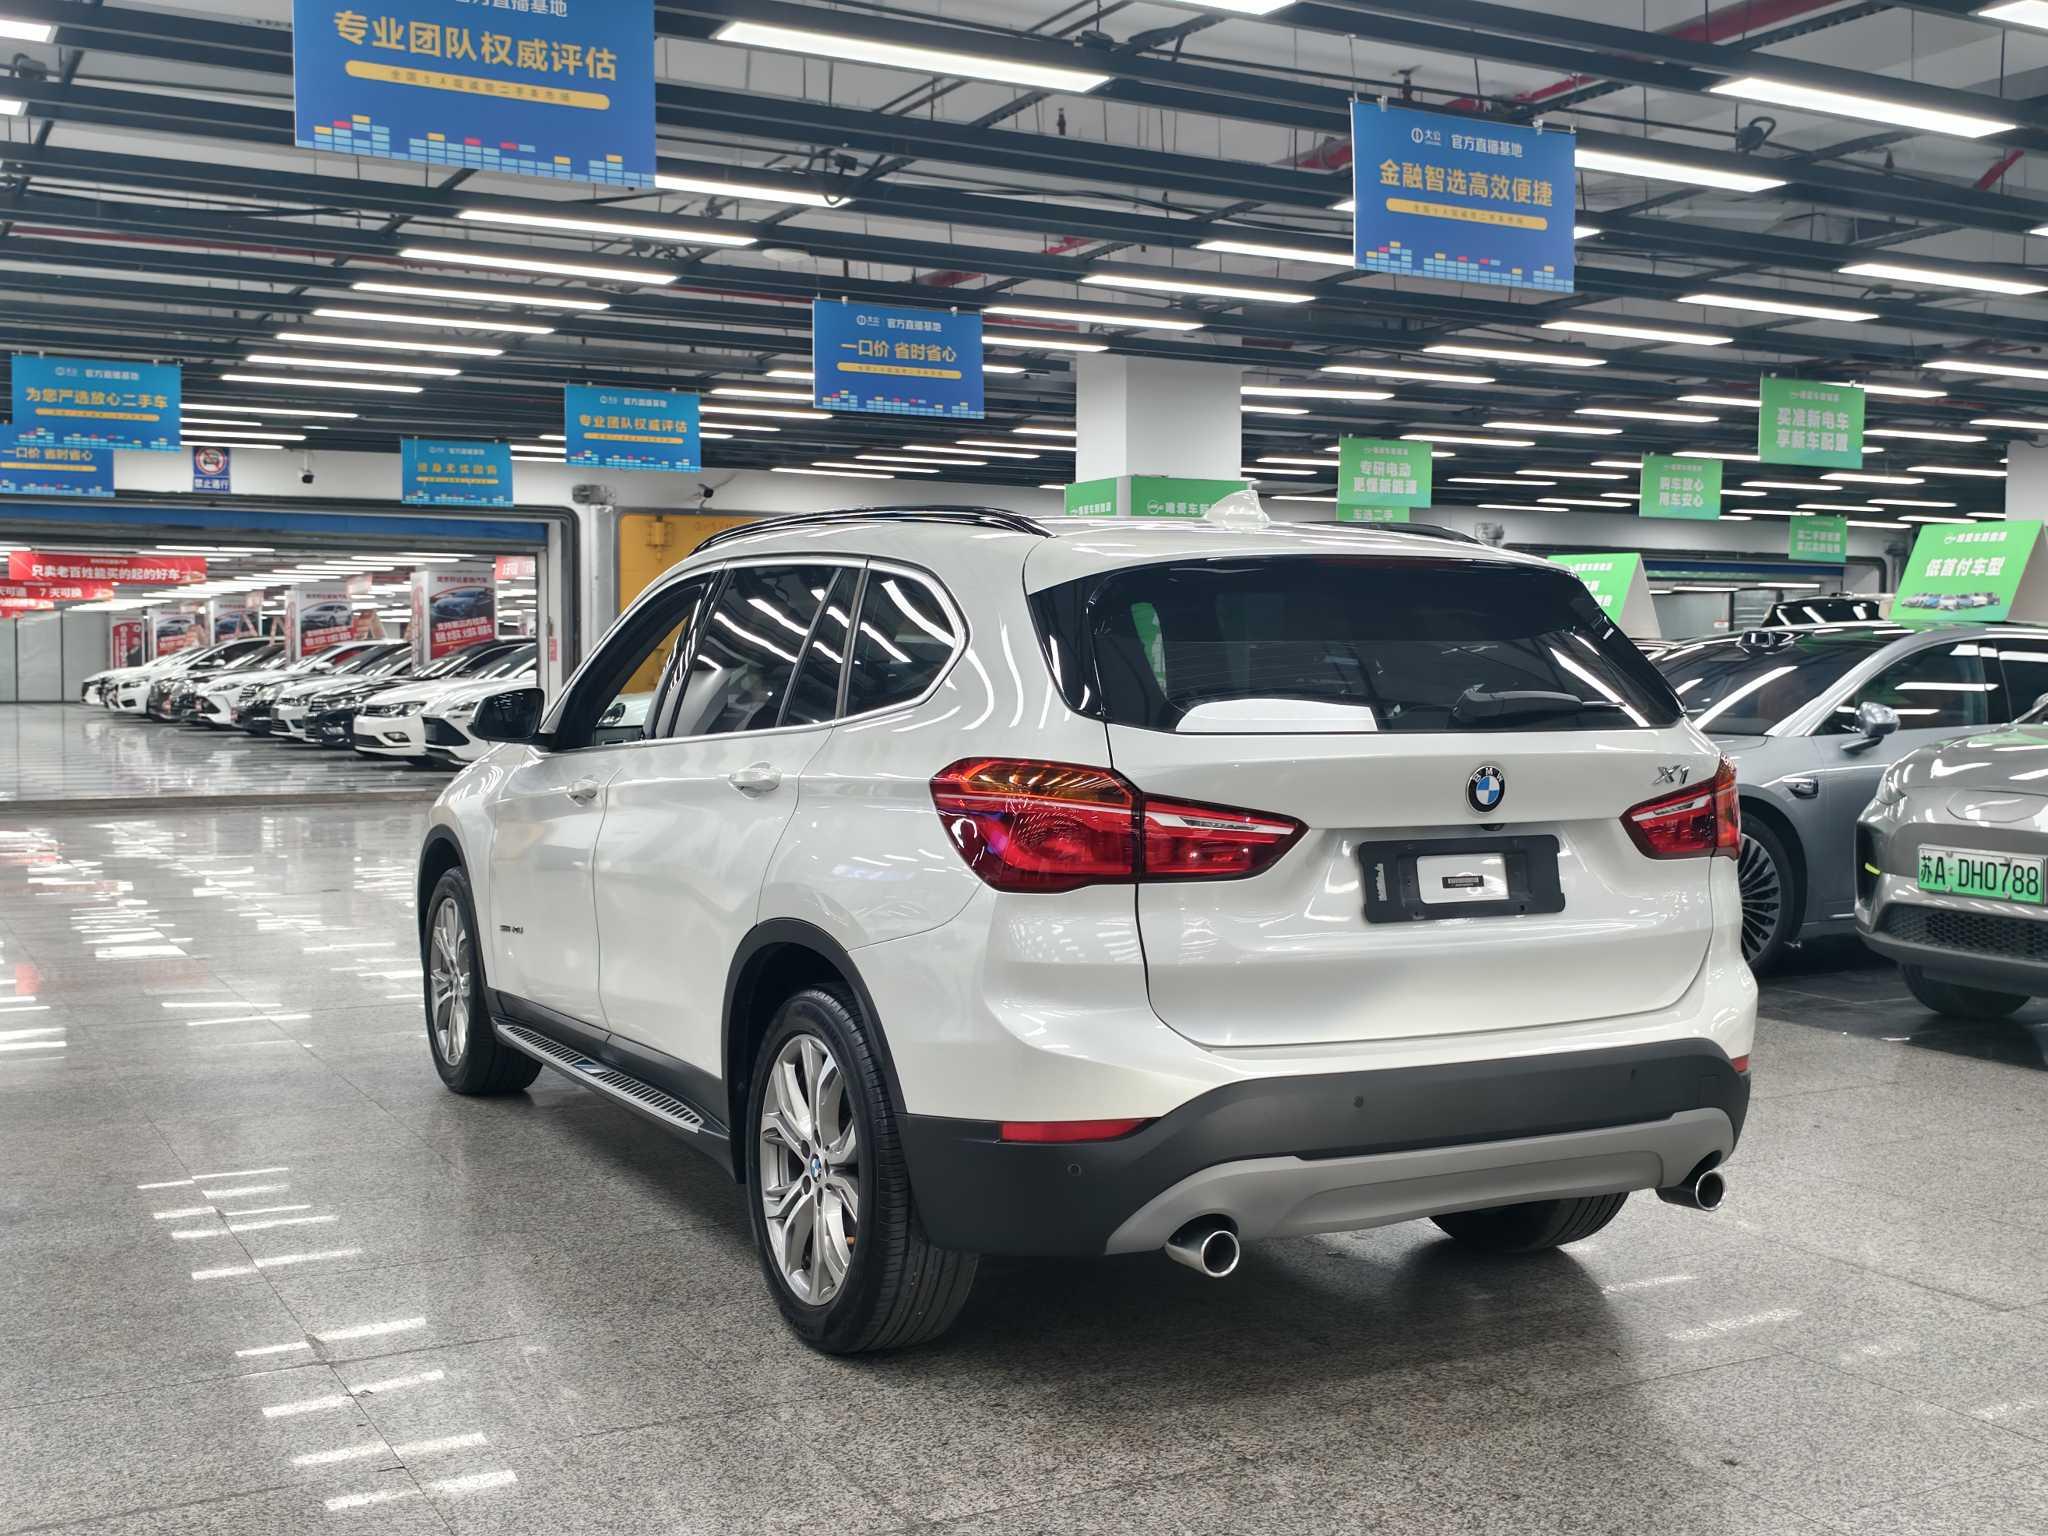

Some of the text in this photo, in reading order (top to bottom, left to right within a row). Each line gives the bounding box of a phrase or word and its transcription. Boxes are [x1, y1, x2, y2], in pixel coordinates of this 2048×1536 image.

[333, 10, 617, 81] 专业团队权威评估
[1451, 133, 1523, 158] 官方直播基地
[1379, 159, 1553, 207] 金融智选高效便捷
[840, 339, 957, 362] 一口价 省时省心
[26, 387, 168, 409] 为您严选放心二手车
[1654, 764, 1690, 785] X1
[1921, 856, 2039, 896] 苏A DH0788
